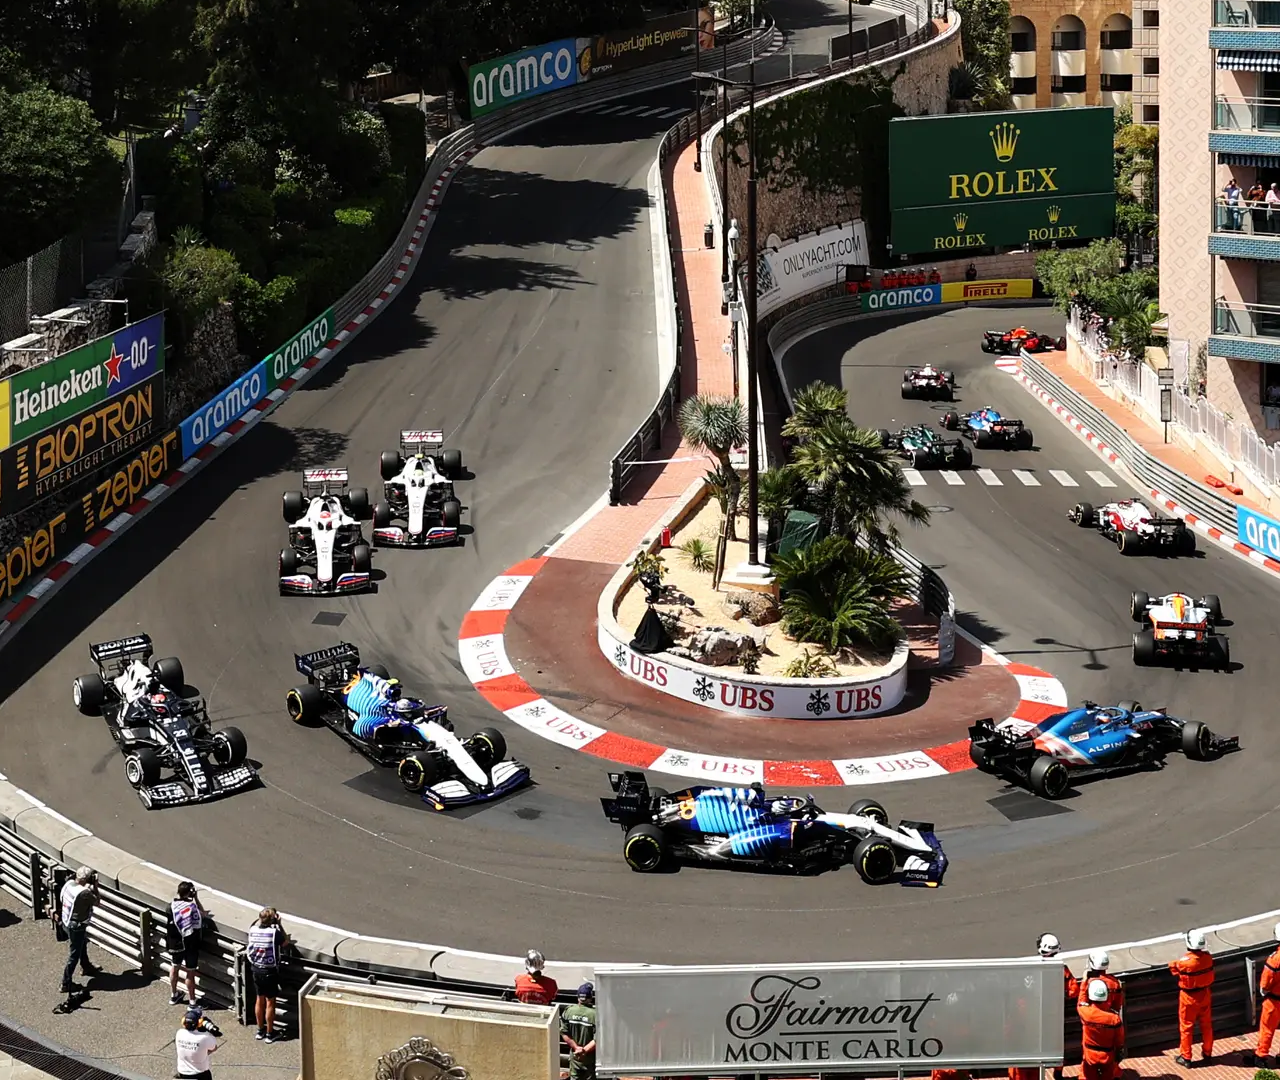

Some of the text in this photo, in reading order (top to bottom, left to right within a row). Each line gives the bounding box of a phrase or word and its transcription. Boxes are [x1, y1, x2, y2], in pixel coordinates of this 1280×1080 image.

[472, 47, 572, 108] aramco
[948, 167, 1059, 199] ROLEX
[933, 233, 987, 250] ROLEX
[1027, 225, 1079, 241] ROLEX
[782, 235, 862, 276] ONLYYACHT.COM
[868, 286, 933, 308] aramco
[962, 282, 1008, 298] PIRELLI
[273, 317, 328, 380] aramco
[13, 362, 102, 426] Heineken
[191, 373, 261, 445] aramco
[35, 424, 153, 496] HYPERLIGHT THERAPY
[98, 635, 144, 652] HONDA
[306, 644, 351, 661] WILLIAMS
[476, 651, 503, 676] UBS
[629, 653, 668, 687] UBS
[720, 683, 775, 712] UBS
[835, 685, 882, 714] UBS
[173, 728, 188, 738] 22
[546, 717, 592, 740] UBS
[1088, 740, 1130, 755] ALPINE
[701, 760, 756, 776] UBS
[876, 756, 930, 773] UBS
[724, 974, 941, 1040] Fairmont
[723, 1036, 944, 1064] MONTE CARLO
